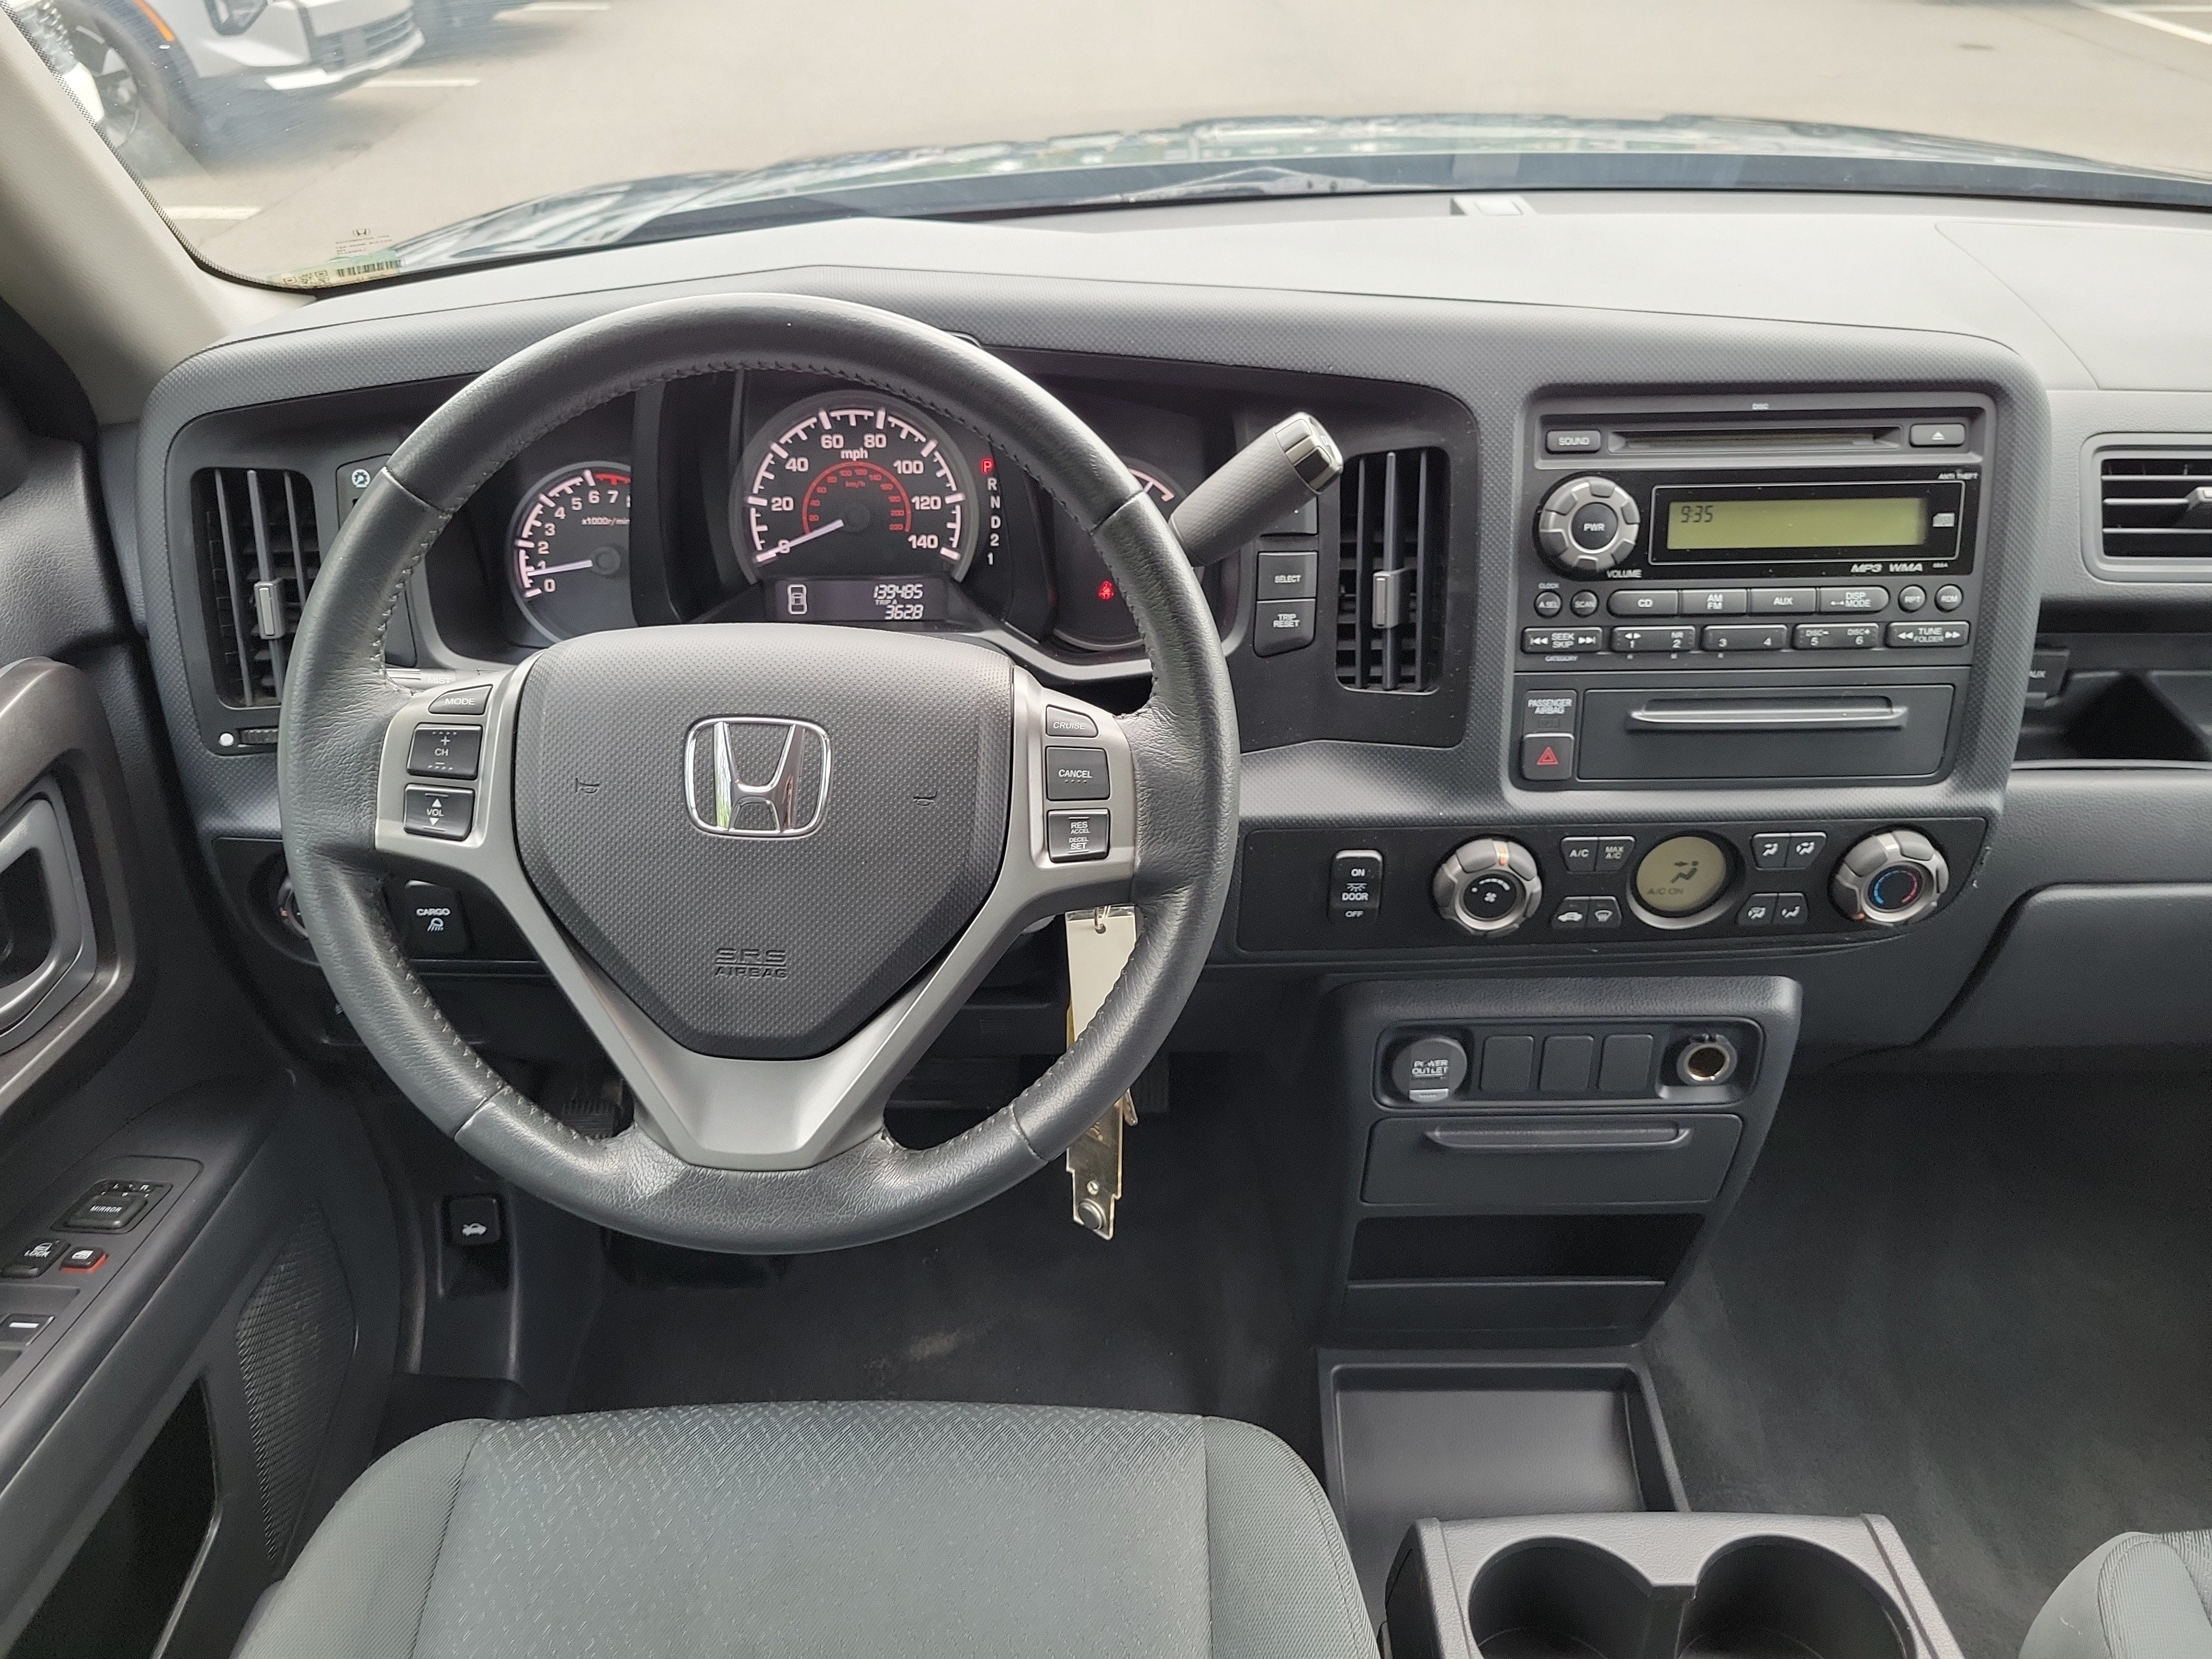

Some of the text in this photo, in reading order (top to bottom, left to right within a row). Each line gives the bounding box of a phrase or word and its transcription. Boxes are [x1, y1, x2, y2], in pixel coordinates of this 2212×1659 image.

[822, 435, 844, 449] 60
[864, 435, 887, 448] 80
[1558, 437, 1590, 445] SOUND
[841, 448, 868, 460] mph
[786, 458, 808, 471] 40
[894, 460, 923, 474] 100
[983, 461, 992, 473] P
[989, 478, 997, 490] R
[589, 489, 600, 504] 6
[607, 489, 618, 504] 7
[571, 497, 582, 511] 5
[771, 497, 794, 511] 20
[912, 496, 941, 510] 120
[991, 496, 1001, 509] N
[555, 506, 566, 519] 4
[991, 516, 1001, 528] D
[545, 523, 555, 536] 3
[1584, 523, 1605, 531] PWR
[909, 534, 938, 549] 140
[990, 533, 1000, 546] 2
[538, 541, 549, 554] 2
[988, 552, 994, 565] 1
[1851, 563, 1882, 573] MP3
[1889, 563, 1923, 572] WMA
[1607, 569, 1642, 578] VOLUME
[1274, 574, 1301, 583] SELECT
[544, 579, 555, 592] 0
[1707, 594, 1723, 602] AM
[1846, 591, 1866, 600] DISP
[1638, 599, 1653, 608] CD
[1707, 602, 1723, 610] FM
[1773, 597, 1793, 606] AUX
[1846, 600, 1871, 608] MODE
[1273, 619, 1300, 628] RESET
[1917, 627, 1943, 635] TUNE
[1551, 633, 1575, 641] SEEK
[1763, 637, 1771, 646] 4
[1810, 637, 1819, 646] 5
[1855, 636, 1864, 645] 6
[1553, 640, 1574, 648] SKIP
[1630, 640, 1635, 648] 1
[1673, 639, 1681, 648] 2
[1718, 638, 1727, 647] 3
[1053, 721, 1086, 730] CRUISE
[434, 748, 449, 757] CH
[1058, 769, 1093, 778] CANCEL
[426, 808, 444, 817] VOL
[1569, 849, 1589, 858] A/C
[1351, 868, 1365, 877] ON
[1342, 892, 1369, 901] DOOR
[416, 907, 451, 916] CARGO
[716, 947, 787, 964] SRS
[715, 967, 787, 980] AIRBAG
[1412, 1066, 1448, 1074] OUTLET
